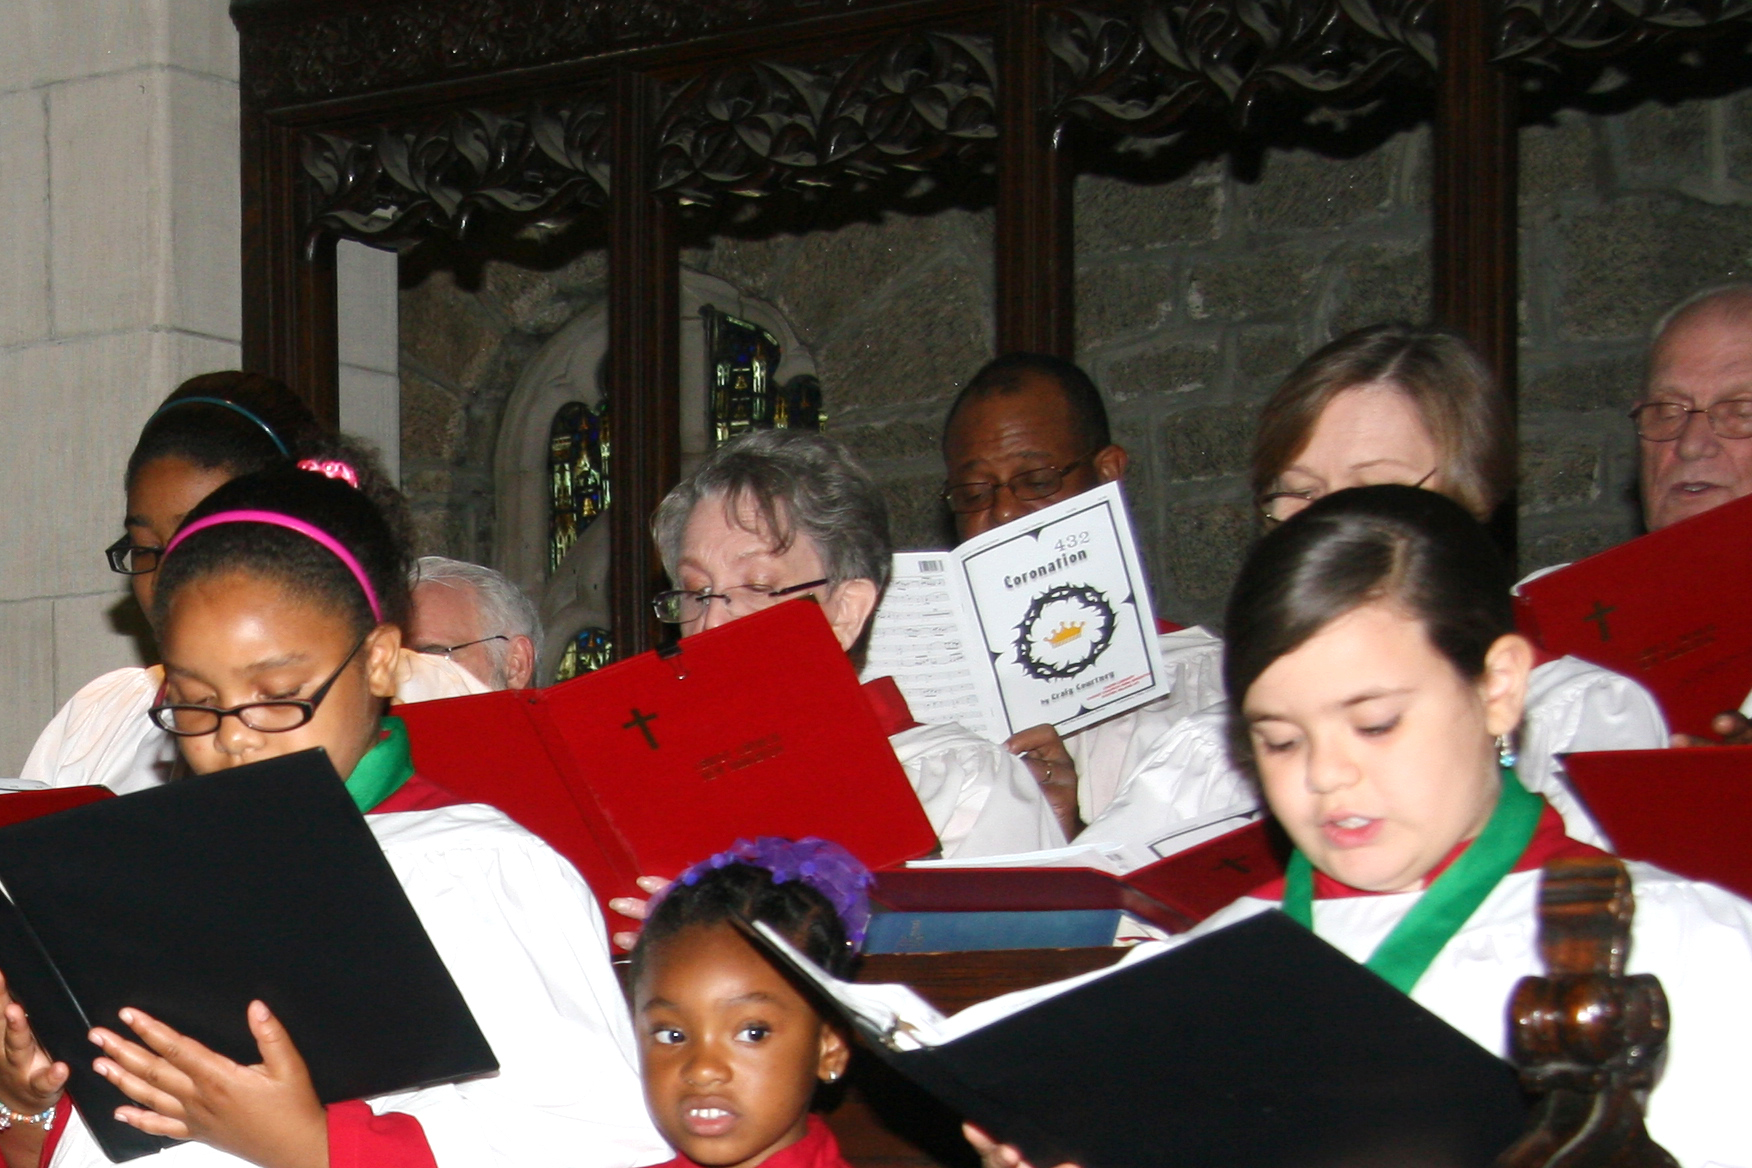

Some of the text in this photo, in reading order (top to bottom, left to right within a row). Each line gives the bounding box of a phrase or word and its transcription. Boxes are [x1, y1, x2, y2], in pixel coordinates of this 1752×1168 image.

[1054, 531, 1090, 552] 432
[1004, 549, 1087, 588] Coronation
[1040, 698, 1050, 706] by
[1051, 687, 1074, 700] Craig
[1076, 671, 1115, 691] Courtney
